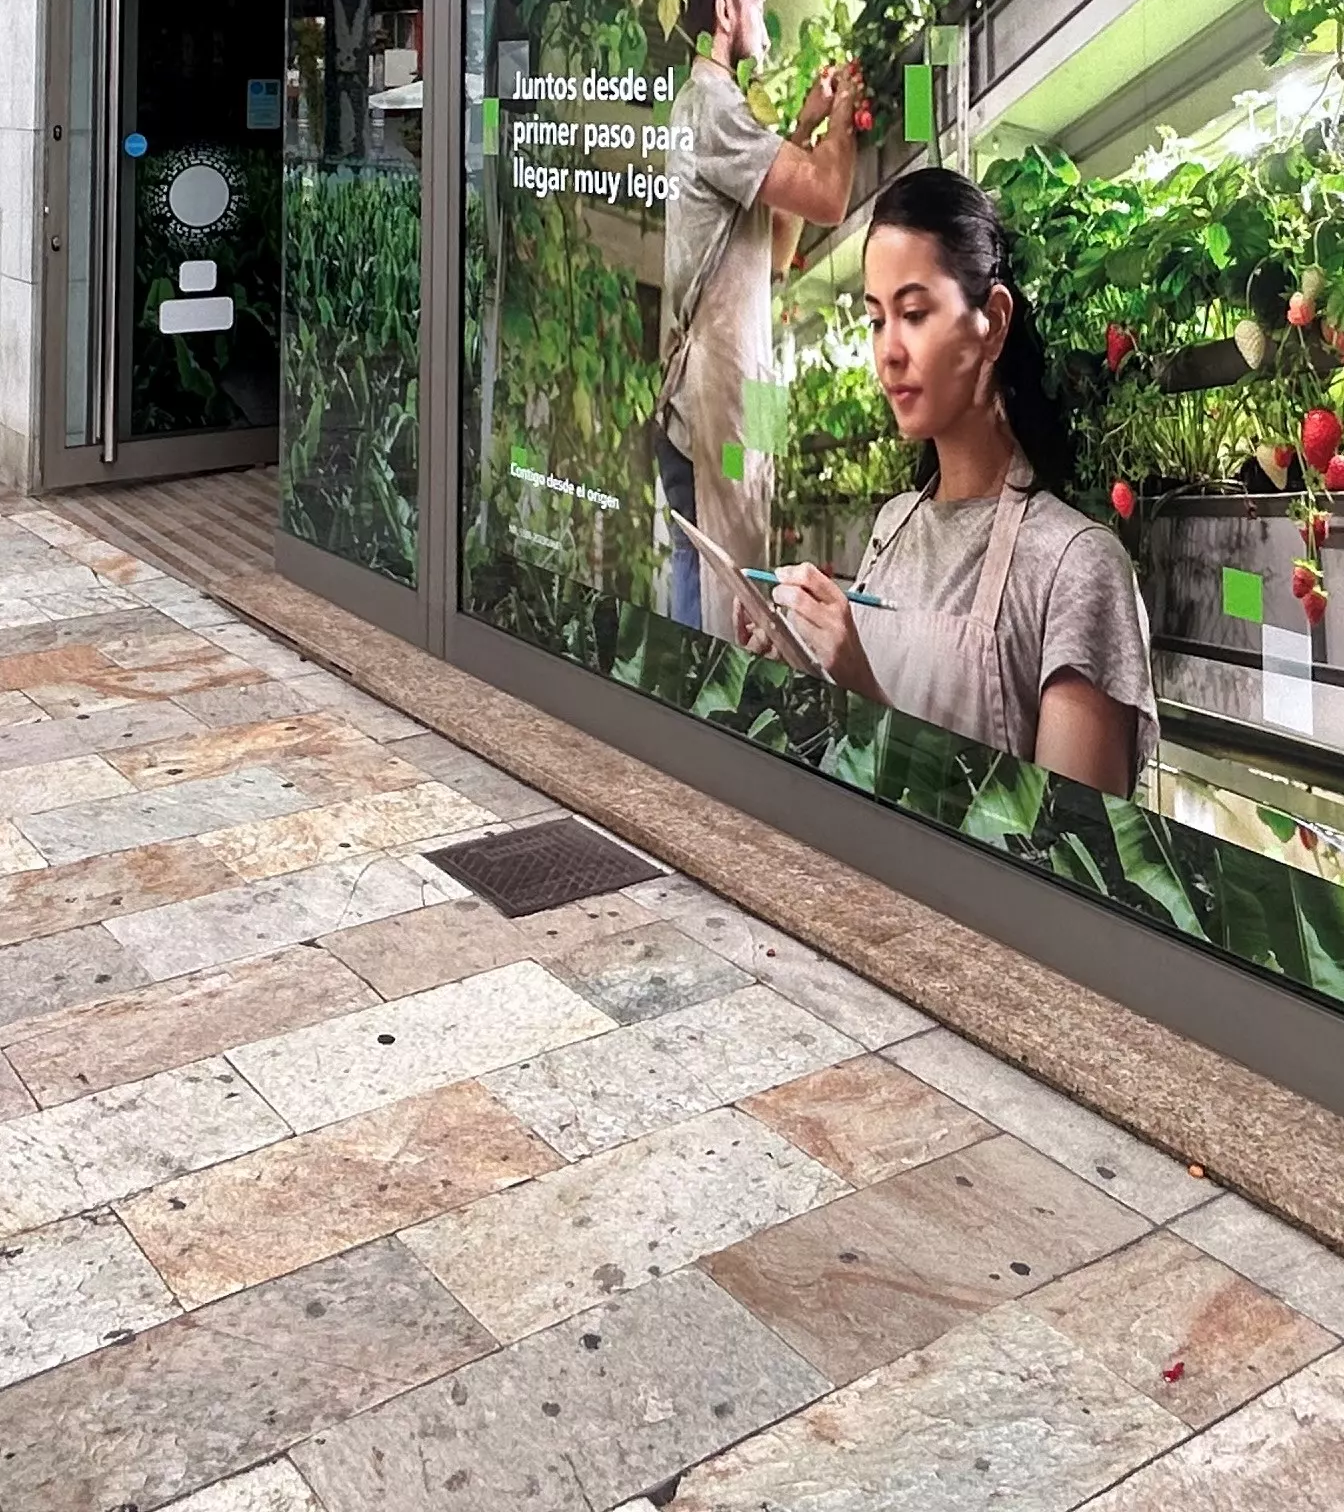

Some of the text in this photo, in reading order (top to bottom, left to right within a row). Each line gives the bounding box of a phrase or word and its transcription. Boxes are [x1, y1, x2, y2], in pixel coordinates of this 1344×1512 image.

[513, 66, 674, 101] Juntos desde el
[513, 113, 694, 158] primer paso para
[513, 156, 680, 208] llegar muy lejos
[546, 472, 575, 495] desde
